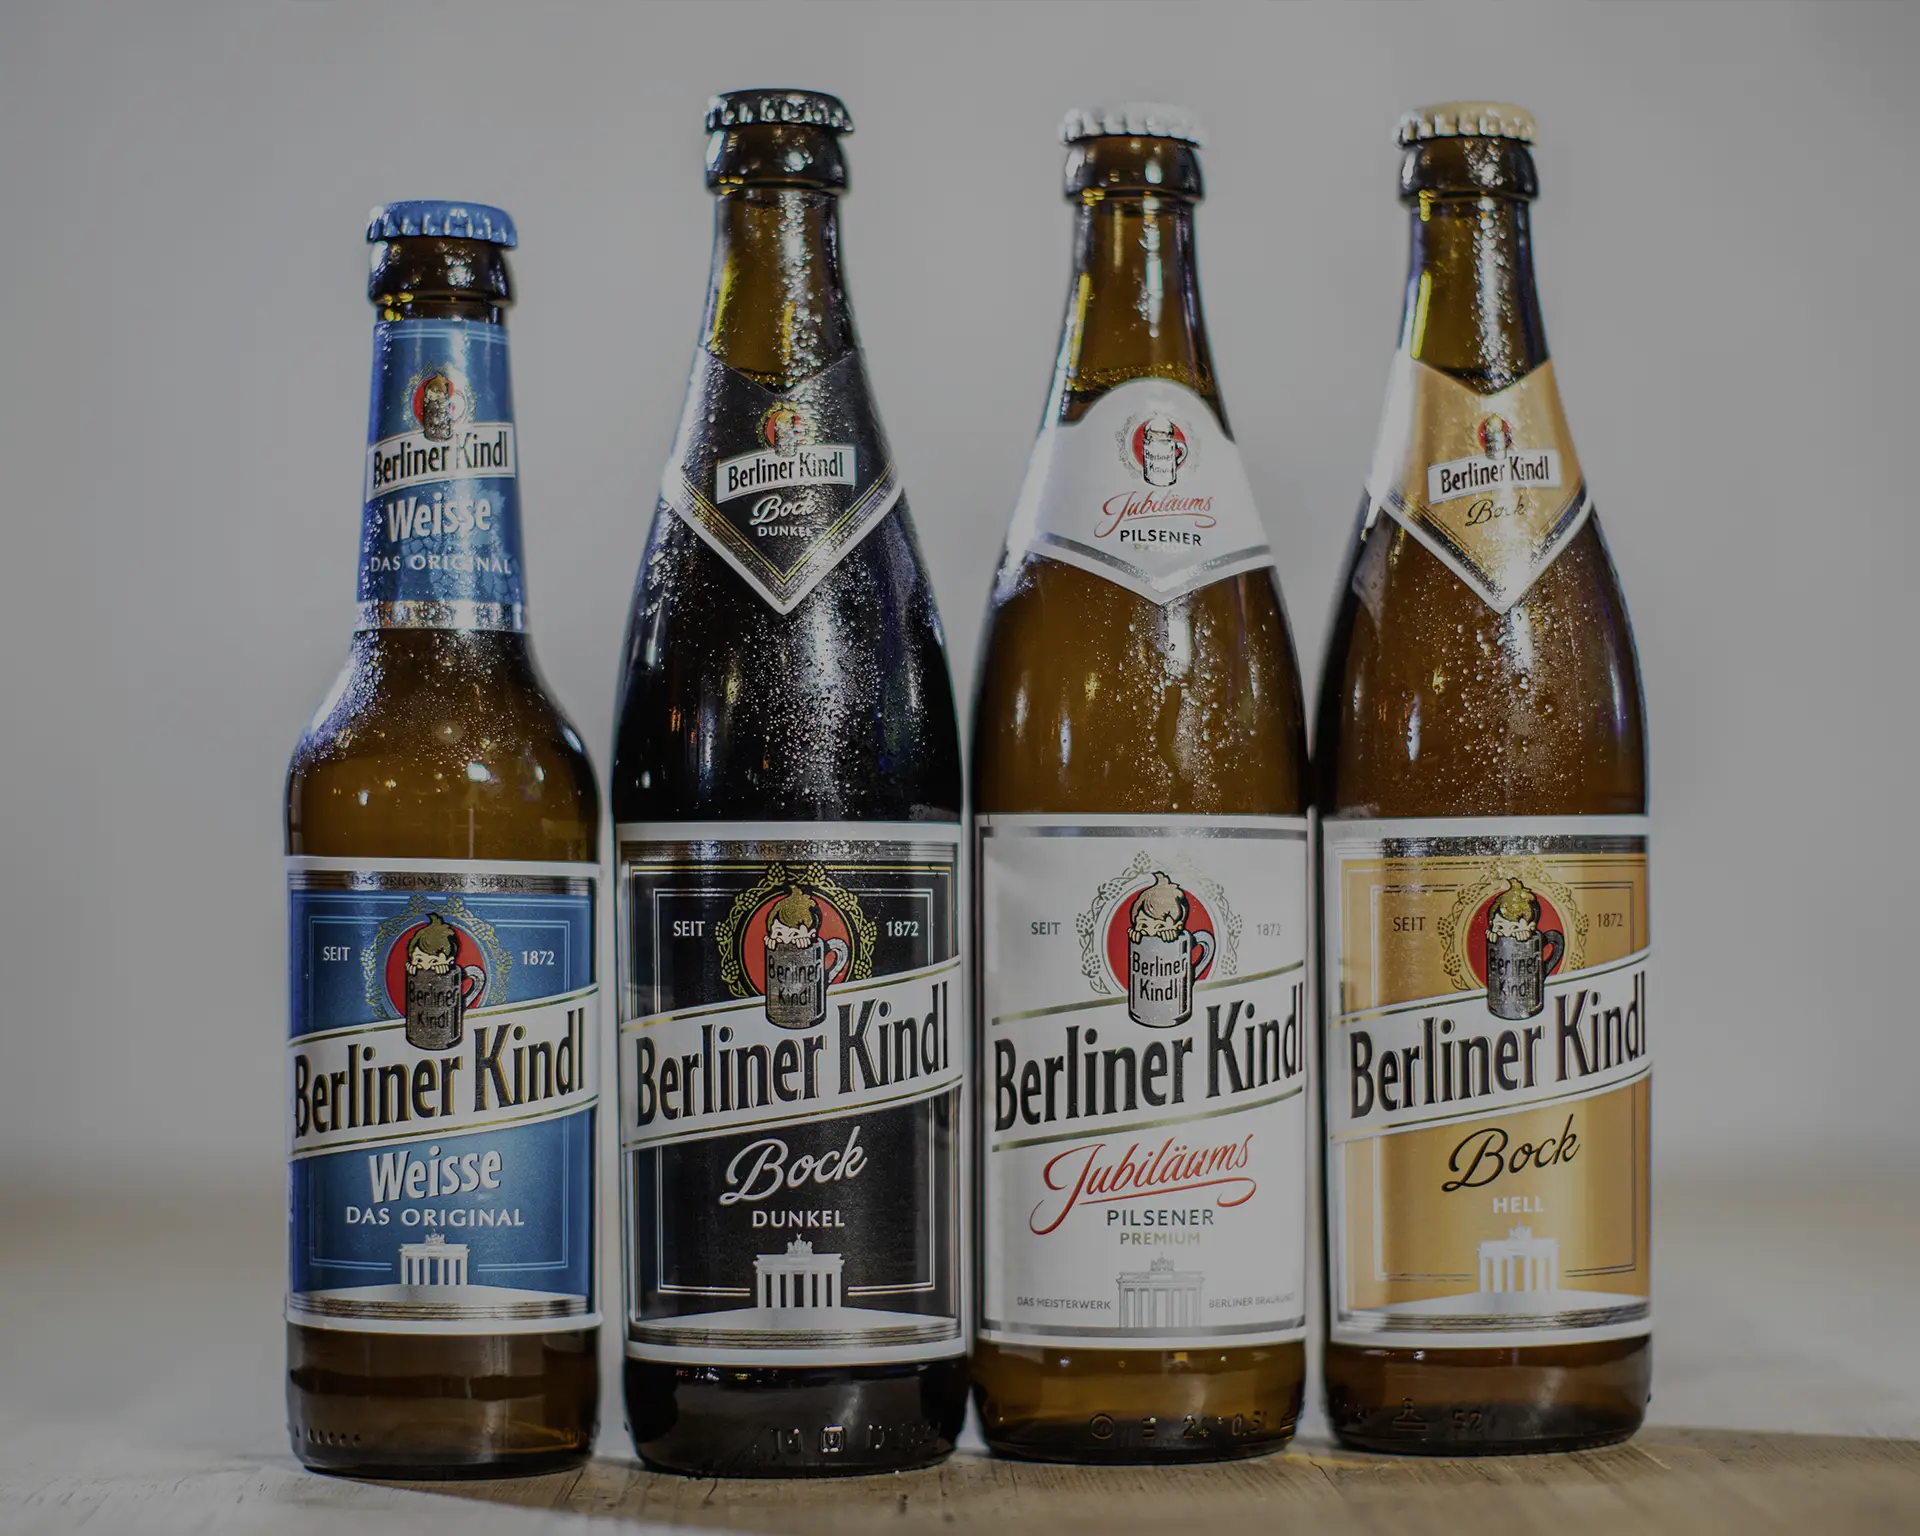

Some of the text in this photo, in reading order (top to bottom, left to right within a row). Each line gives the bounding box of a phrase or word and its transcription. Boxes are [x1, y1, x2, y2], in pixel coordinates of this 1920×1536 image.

[374, 431, 508, 488] Berliner Kindl
[729, 451, 844, 493] Berliner Kindl
[1441, 455, 1549, 495] Berliner Kindl
[388, 492, 491, 543] Weisse
[750, 489, 817, 525] Bock
[1094, 490, 1217, 538] Jubiläums
[758, 525, 812, 537] DUNKEL
[1120, 529, 1202, 546] PILSENER
[370, 556, 401, 572] DAS
[351, 875, 524, 888] DAS ORIGINAL AUS BERLIN
[673, 921, 705, 937] SEIT
[886, 921, 920, 937] 1872
[1031, 922, 1060, 936] SEIT
[1393, 917, 1426, 932] SEIT
[1596, 913, 1623, 928] 1872
[322, 946, 351, 962] SEIT
[522, 950, 555, 965] 1872
[1132, 951, 1188, 978] Berliner
[768, 955, 820, 984] Berliner
[409, 979, 458, 1007] Berliner
[779, 986, 811, 1006] Kindl
[1139, 978, 1178, 1002] Kindl
[417, 1010, 449, 1029] Kindl
[636, 980, 949, 1128] Berliner Kindl
[1350, 971, 1646, 1119] Berliner Kindl
[994, 981, 1304, 1132] Berliner Kindl
[294, 1008, 585, 1139] Berliner Kindl
[1441, 1113, 1581, 1193] Bock
[368, 1146, 502, 1204] Weisse
[719, 1125, 868, 1205] Bock
[1029, 1134, 1257, 1235] Jubiläums
[1493, 1196, 1545, 1213] HELL
[346, 1206, 525, 1228] DAS ORIGINAL
[752, 1210, 845, 1227] DUNKEL
[1106, 1209, 1214, 1226] PILSENER
[1120, 1232, 1200, 1245] PREMIUM
[1016, 1296, 1111, 1310] DAS MEISTERWERK
[1209, 1297, 1253, 1309] BERLINER
